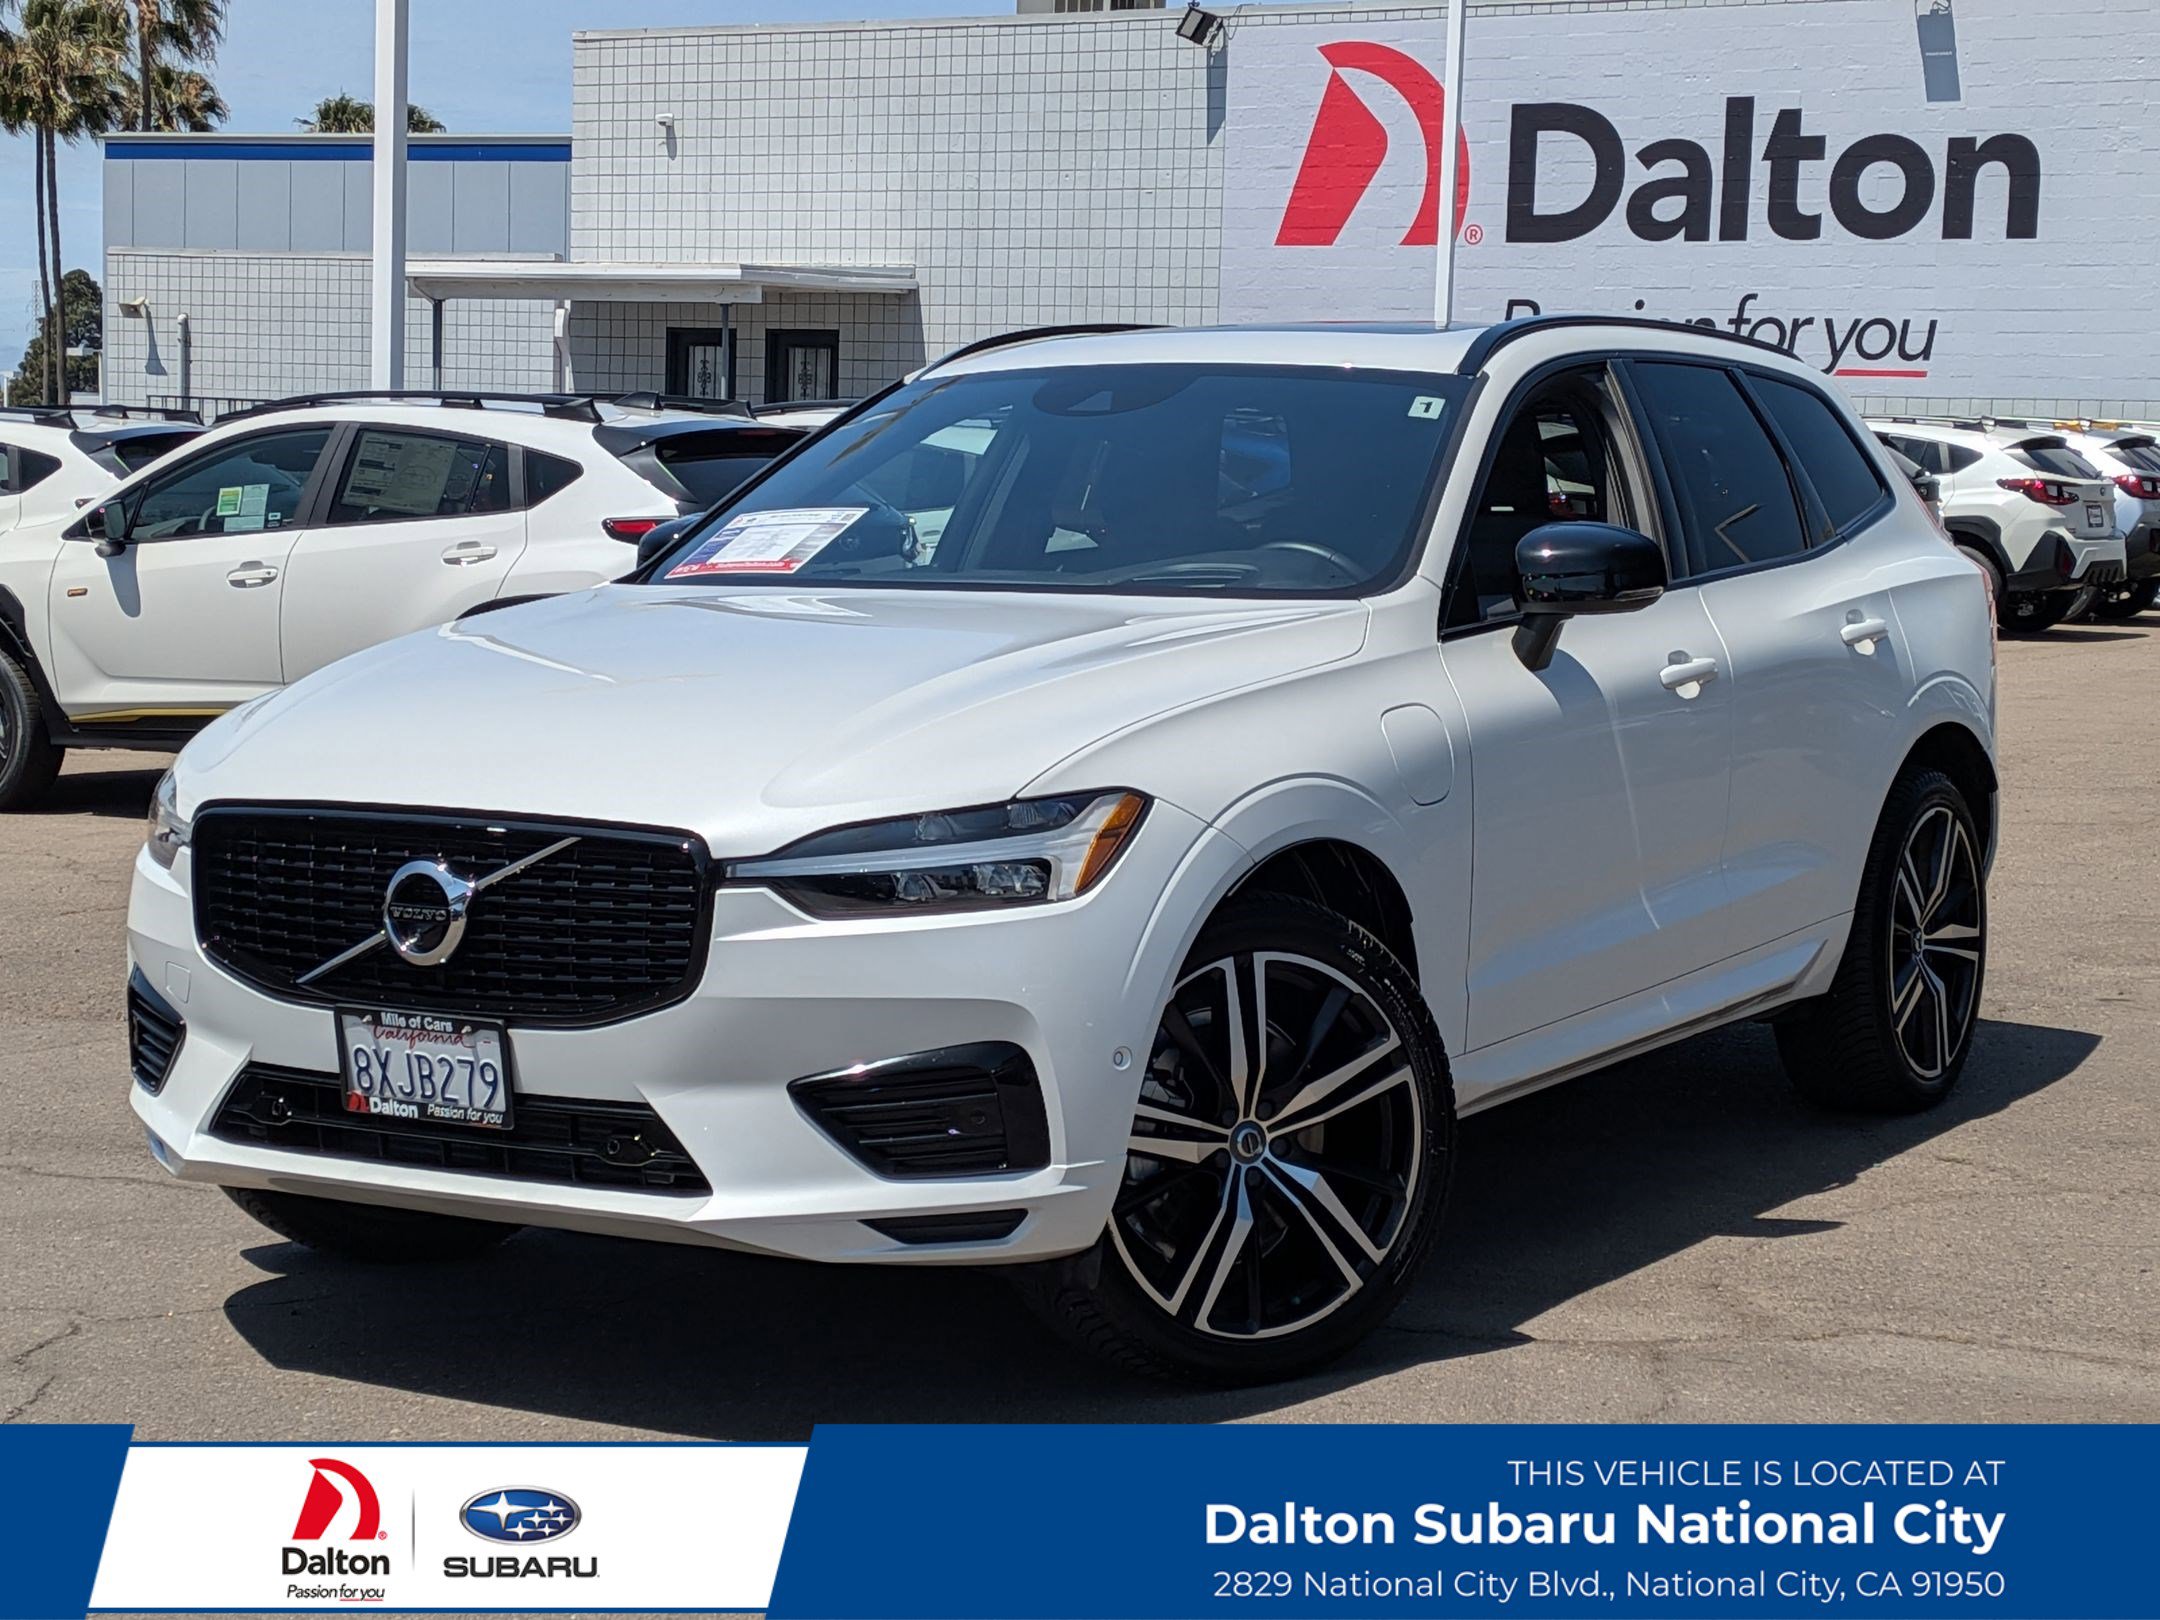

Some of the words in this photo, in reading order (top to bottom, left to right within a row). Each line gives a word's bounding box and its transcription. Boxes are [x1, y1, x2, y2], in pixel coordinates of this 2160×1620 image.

[1506, 96, 2041, 243] Dalton
[1822, 316, 1938, 376] you
[389, 906, 448, 922] VOLVO
[381, 1012, 407, 1028] Mile
[408, 1016, 422, 1029] of
[424, 1017, 454, 1032] Cars
[353, 1046, 499, 1110] 8XJB279
[369, 1097, 419, 1119] Dalton
[427, 1103, 464, 1119] Passion
[466, 1107, 482, 1121] for
[484, 1112, 503, 1125] you
